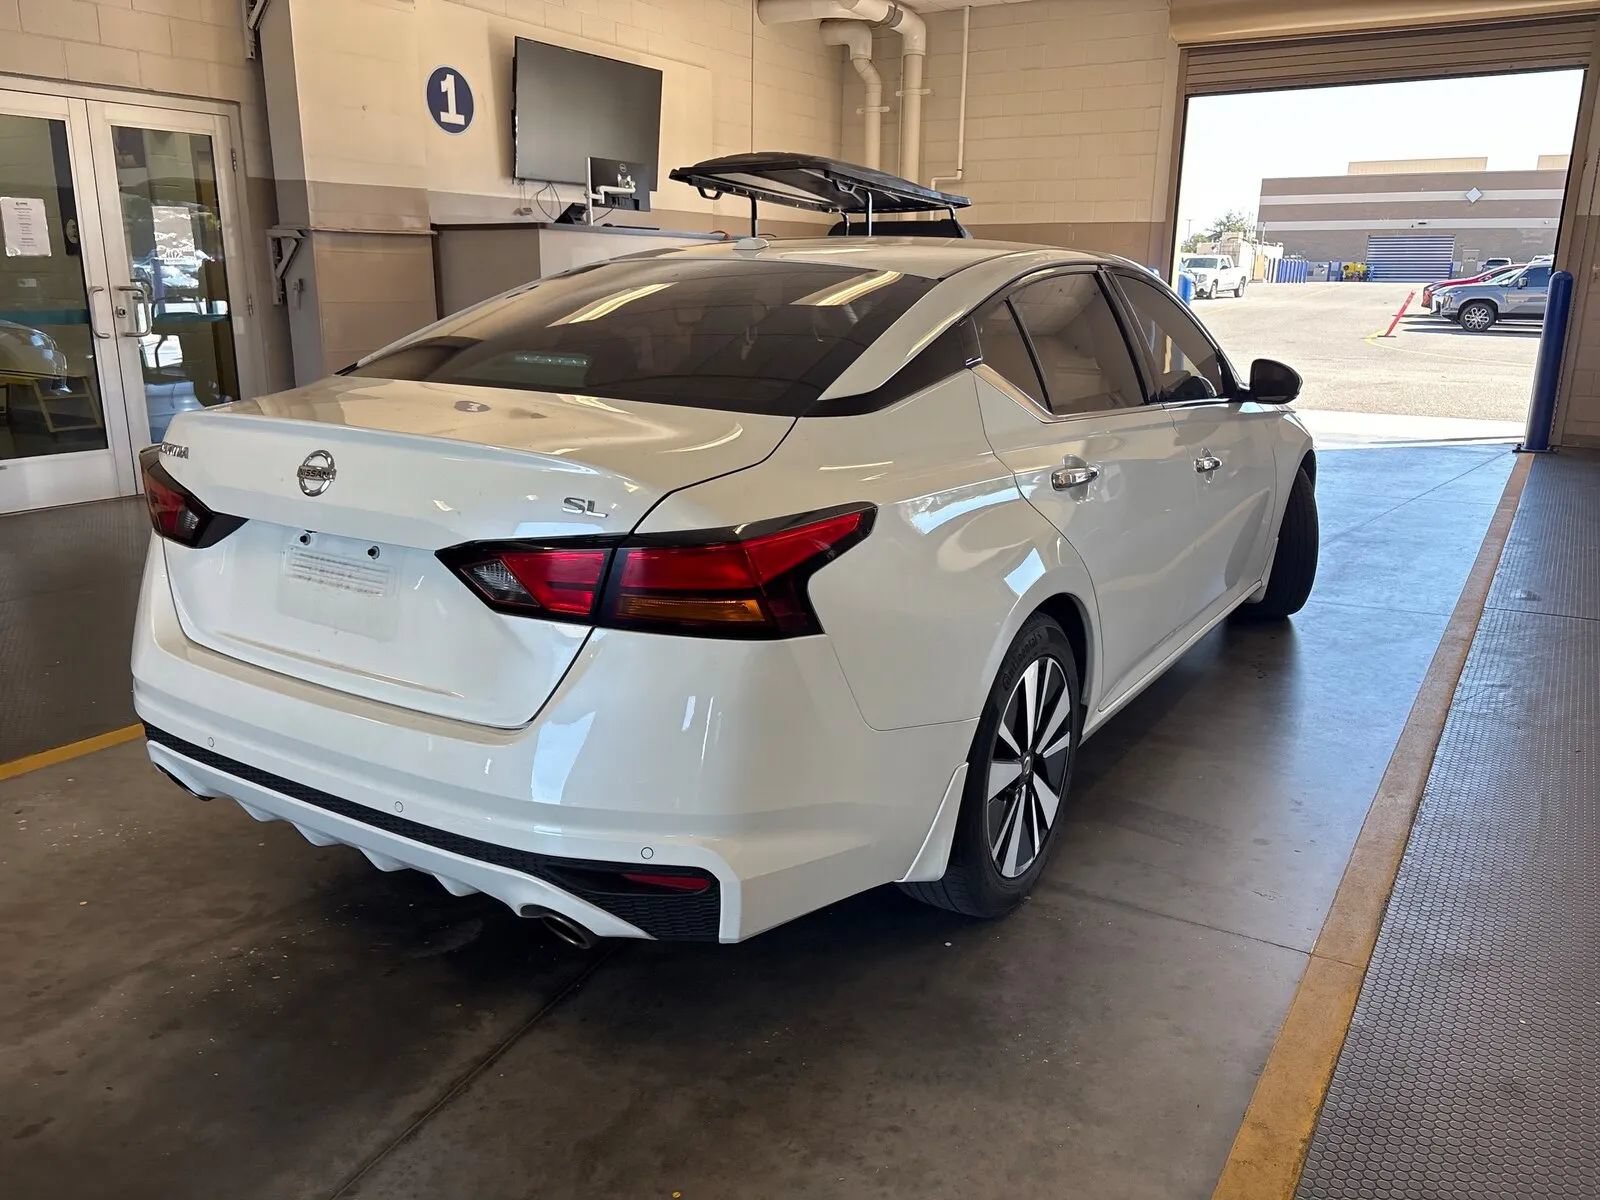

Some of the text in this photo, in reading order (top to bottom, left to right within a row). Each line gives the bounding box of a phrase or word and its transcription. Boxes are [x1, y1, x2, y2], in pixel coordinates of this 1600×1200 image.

[440, 73, 466, 126] 1
[299, 467, 333, 479] NISSAN
[561, 496, 609, 518] SL
